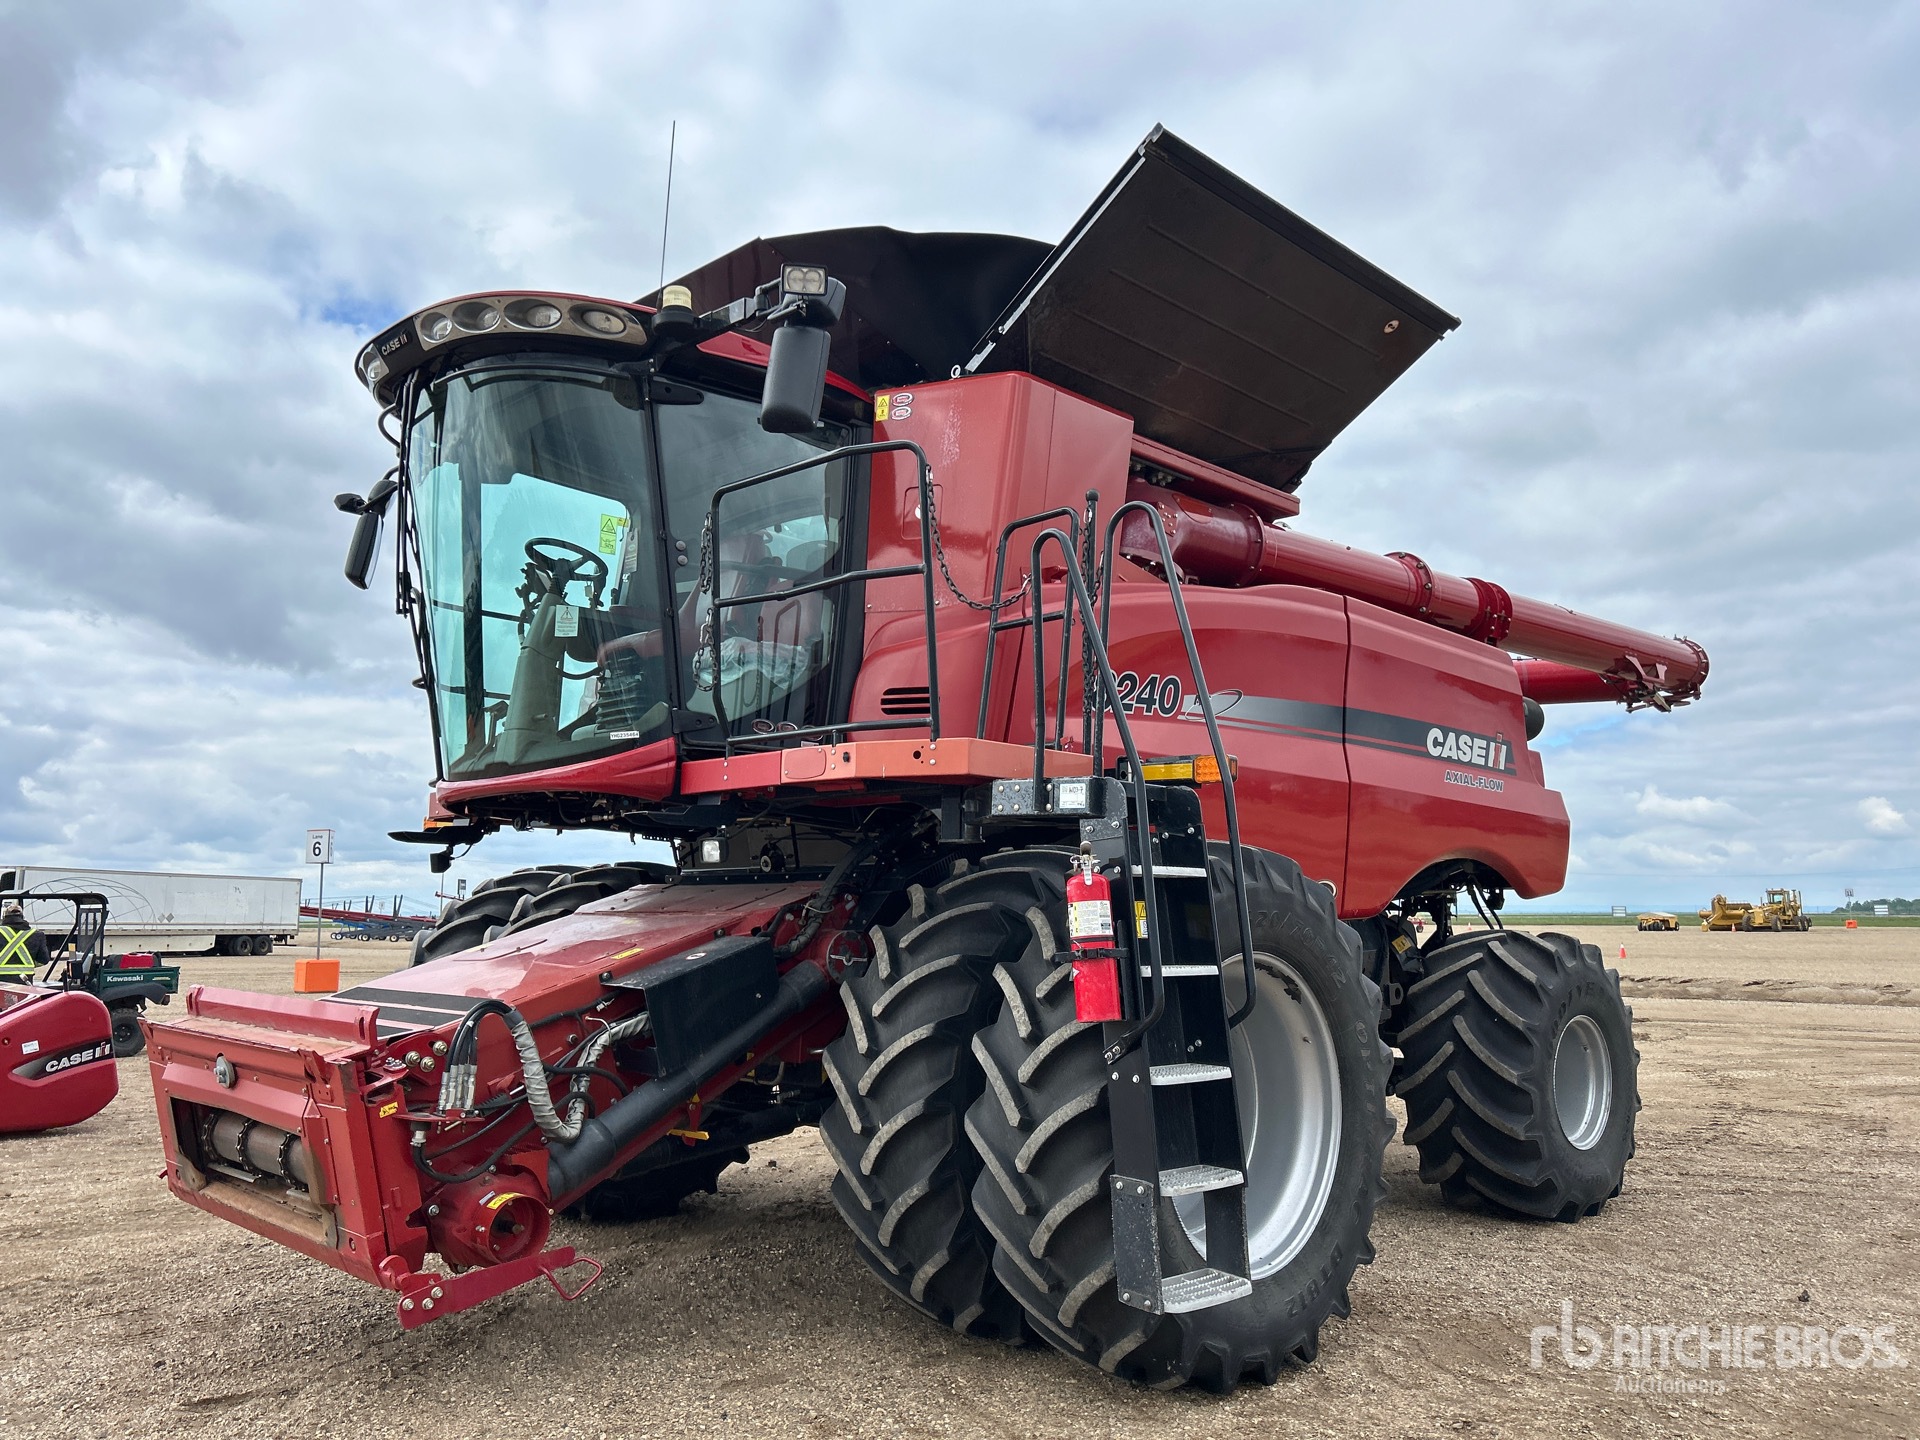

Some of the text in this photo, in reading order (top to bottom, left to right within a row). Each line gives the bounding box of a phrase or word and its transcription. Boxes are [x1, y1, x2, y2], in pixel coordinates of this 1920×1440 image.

[382, 338, 400, 355] CASE
[1426, 727, 1487, 766] CASE
[1444, 769, 1504, 793] AXIAL-FLOW
[312, 840, 322, 857] 6
[106, 974, 144, 982] Kawasaki
[45, 1049, 94, 1073] CASE
